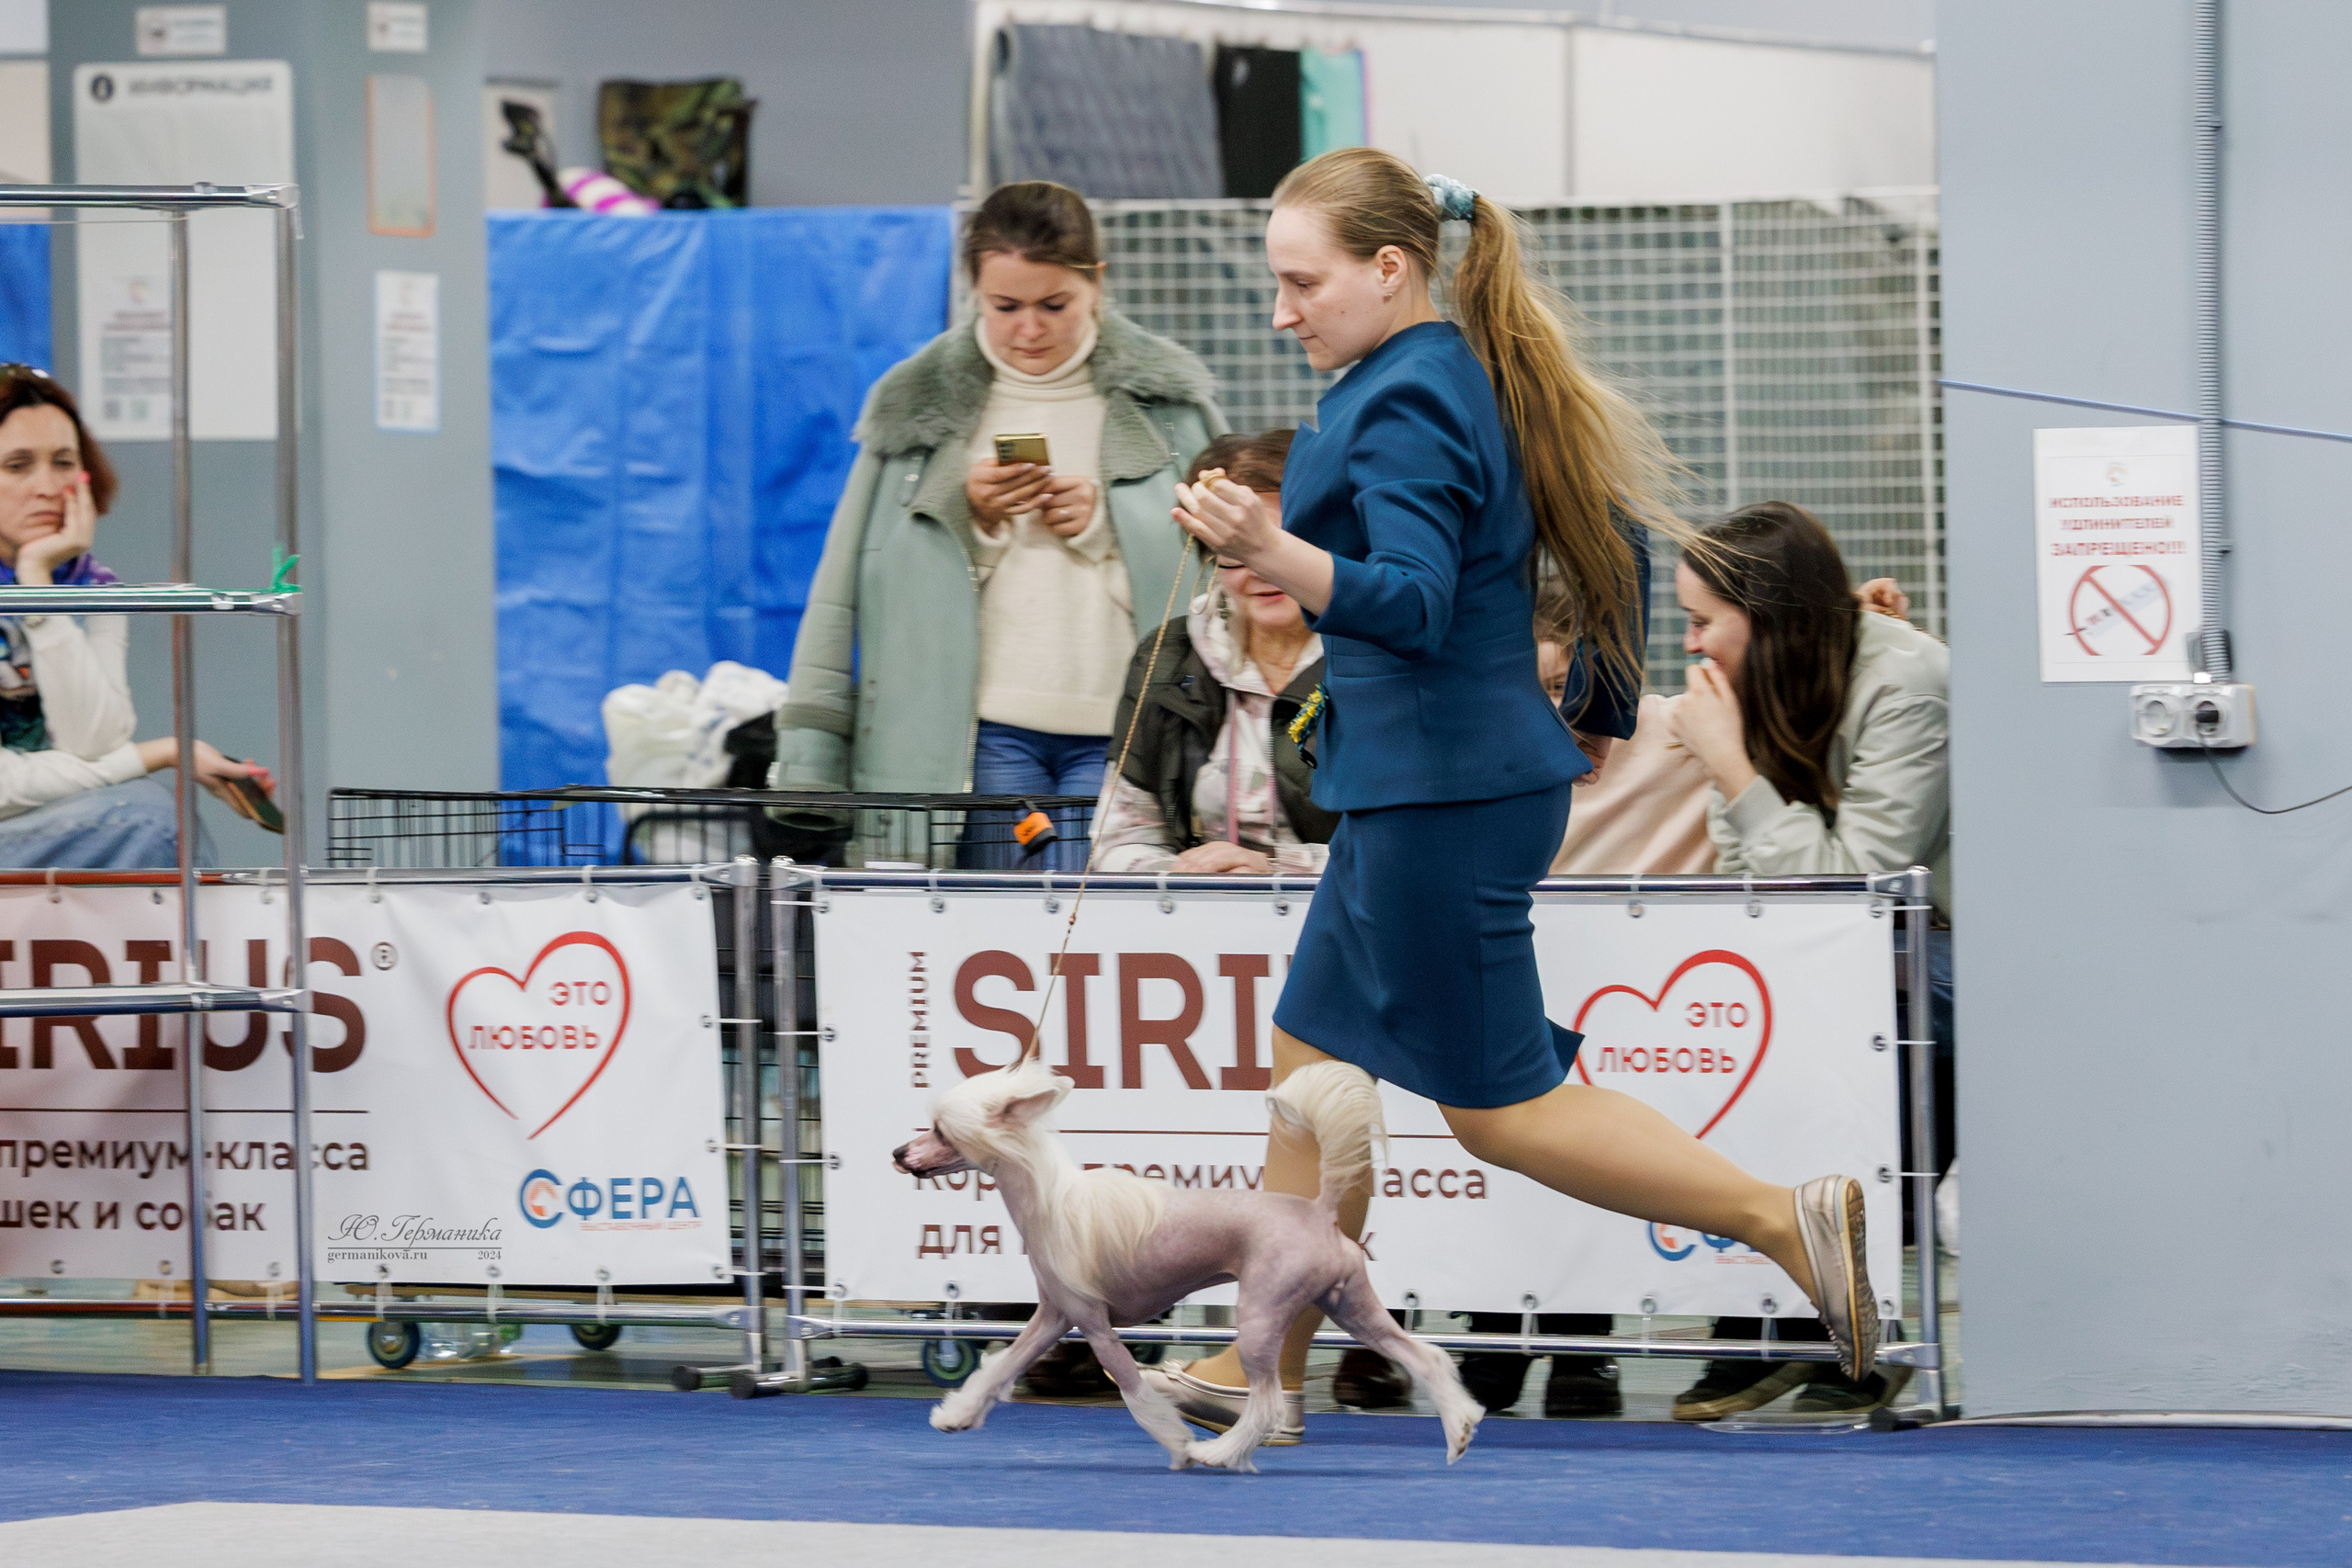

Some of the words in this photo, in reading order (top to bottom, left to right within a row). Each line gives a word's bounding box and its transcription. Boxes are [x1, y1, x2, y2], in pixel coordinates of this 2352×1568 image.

[2049, 495, 2185, 508] ИСПОЛЬЗОВАНИЕ
[548, 980, 612, 1006] ЭТО
[910, 951, 930, 1089] PREMIUM
[953, 949, 1294, 1090] SIRI
[1684, 1001, 1749, 1028] ЭТО
[469, 1025, 601, 1050] ЛЮБОВЬ
[1596, 1047, 1737, 1073] ЛЮБОВЬ
[95, 1201, 120, 1229] и
[135, 1191, 267, 1231] соак
[519, 1168, 702, 1229] СФЕРА
[917, 1224, 1002, 1259] для
